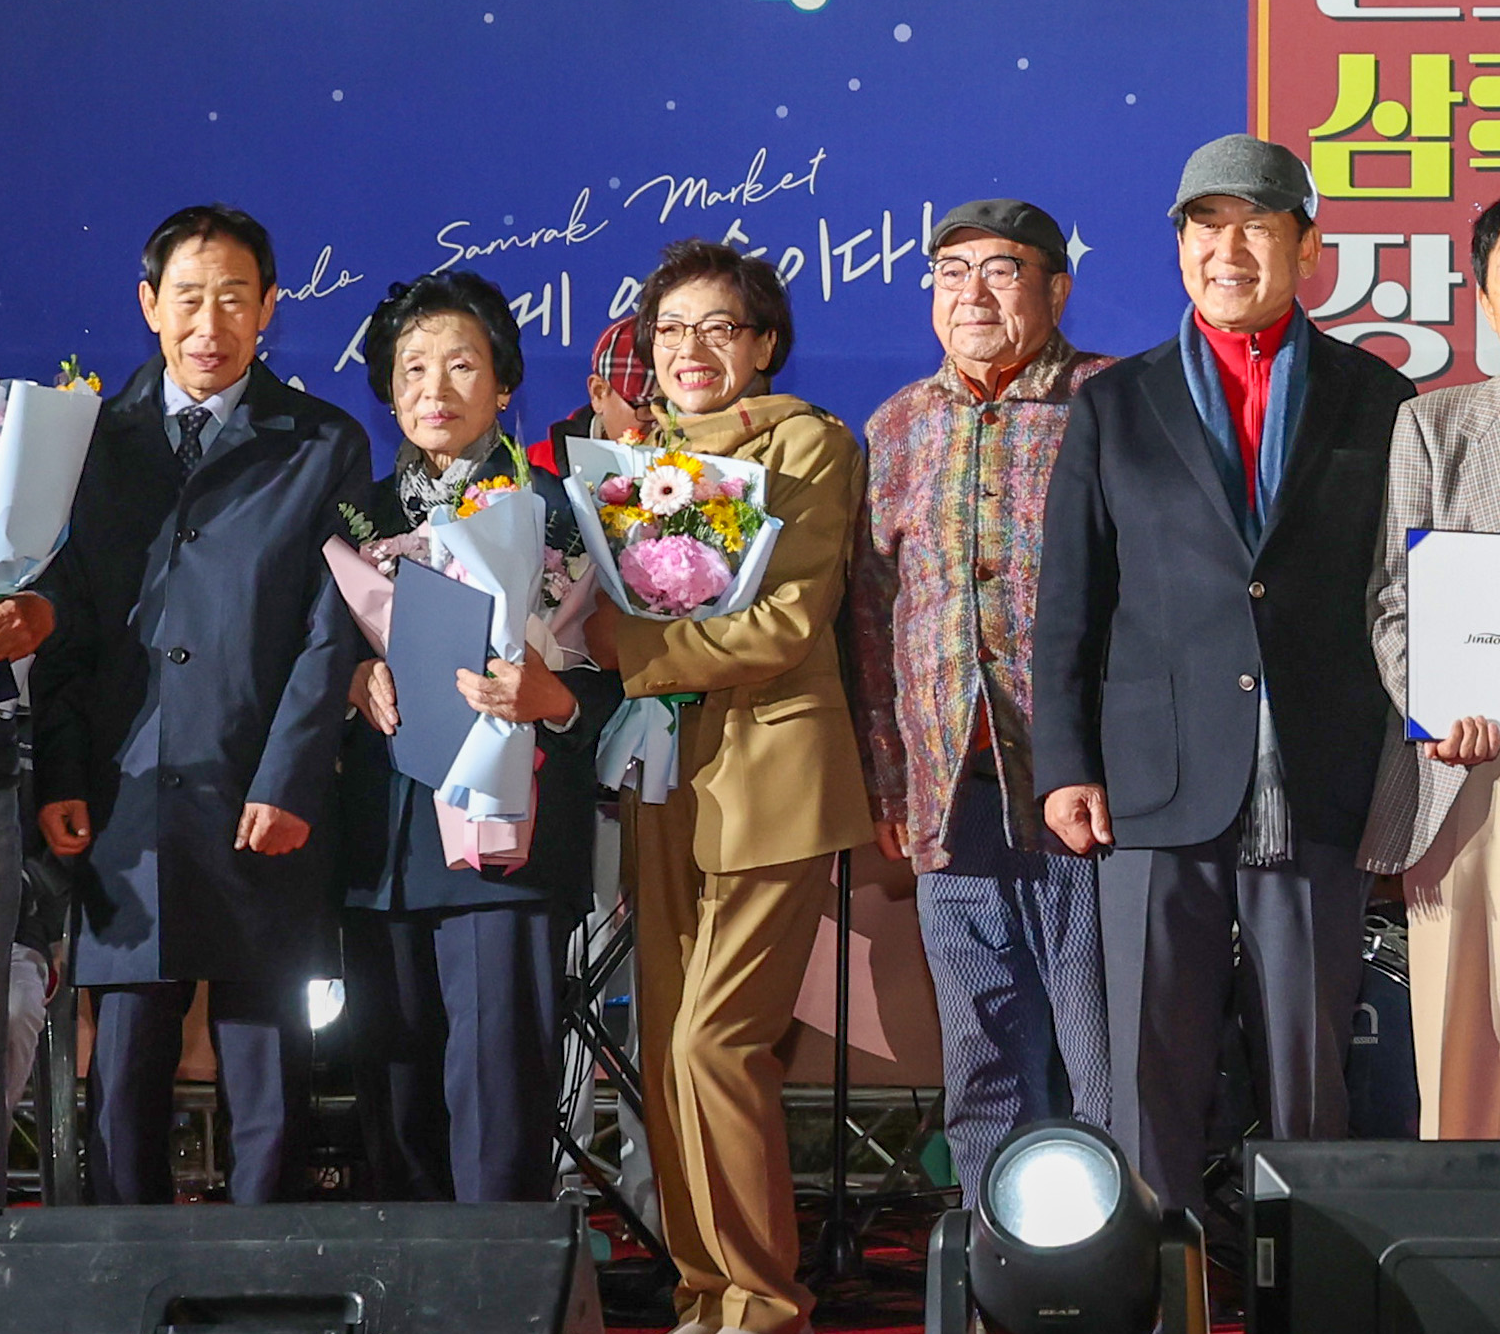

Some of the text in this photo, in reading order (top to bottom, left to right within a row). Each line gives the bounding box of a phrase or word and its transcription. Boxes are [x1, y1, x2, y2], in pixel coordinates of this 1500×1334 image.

[276, 146, 828, 302] ndo Samrak Market
